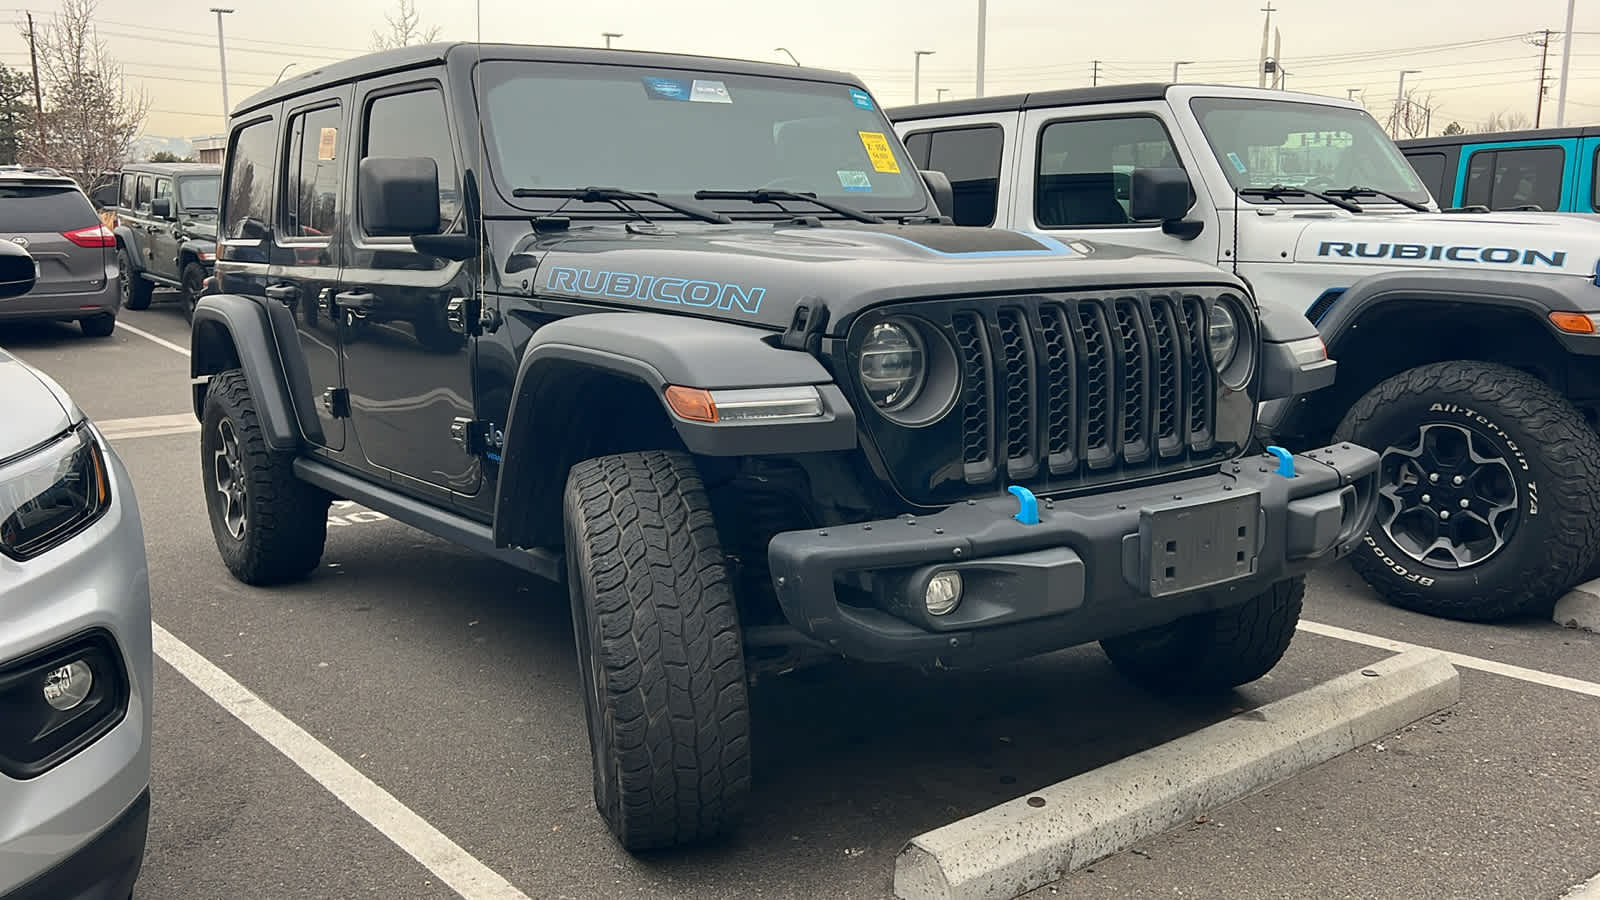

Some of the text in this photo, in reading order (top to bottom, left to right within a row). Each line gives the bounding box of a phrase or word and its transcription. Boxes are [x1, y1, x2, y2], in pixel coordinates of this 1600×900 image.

[1317, 241, 1569, 268] RUBICON
[546, 266, 766, 314] RUBICON
[1429, 402, 1539, 515] All-Terrain T/A
[1363, 532, 1436, 587] BFGood
